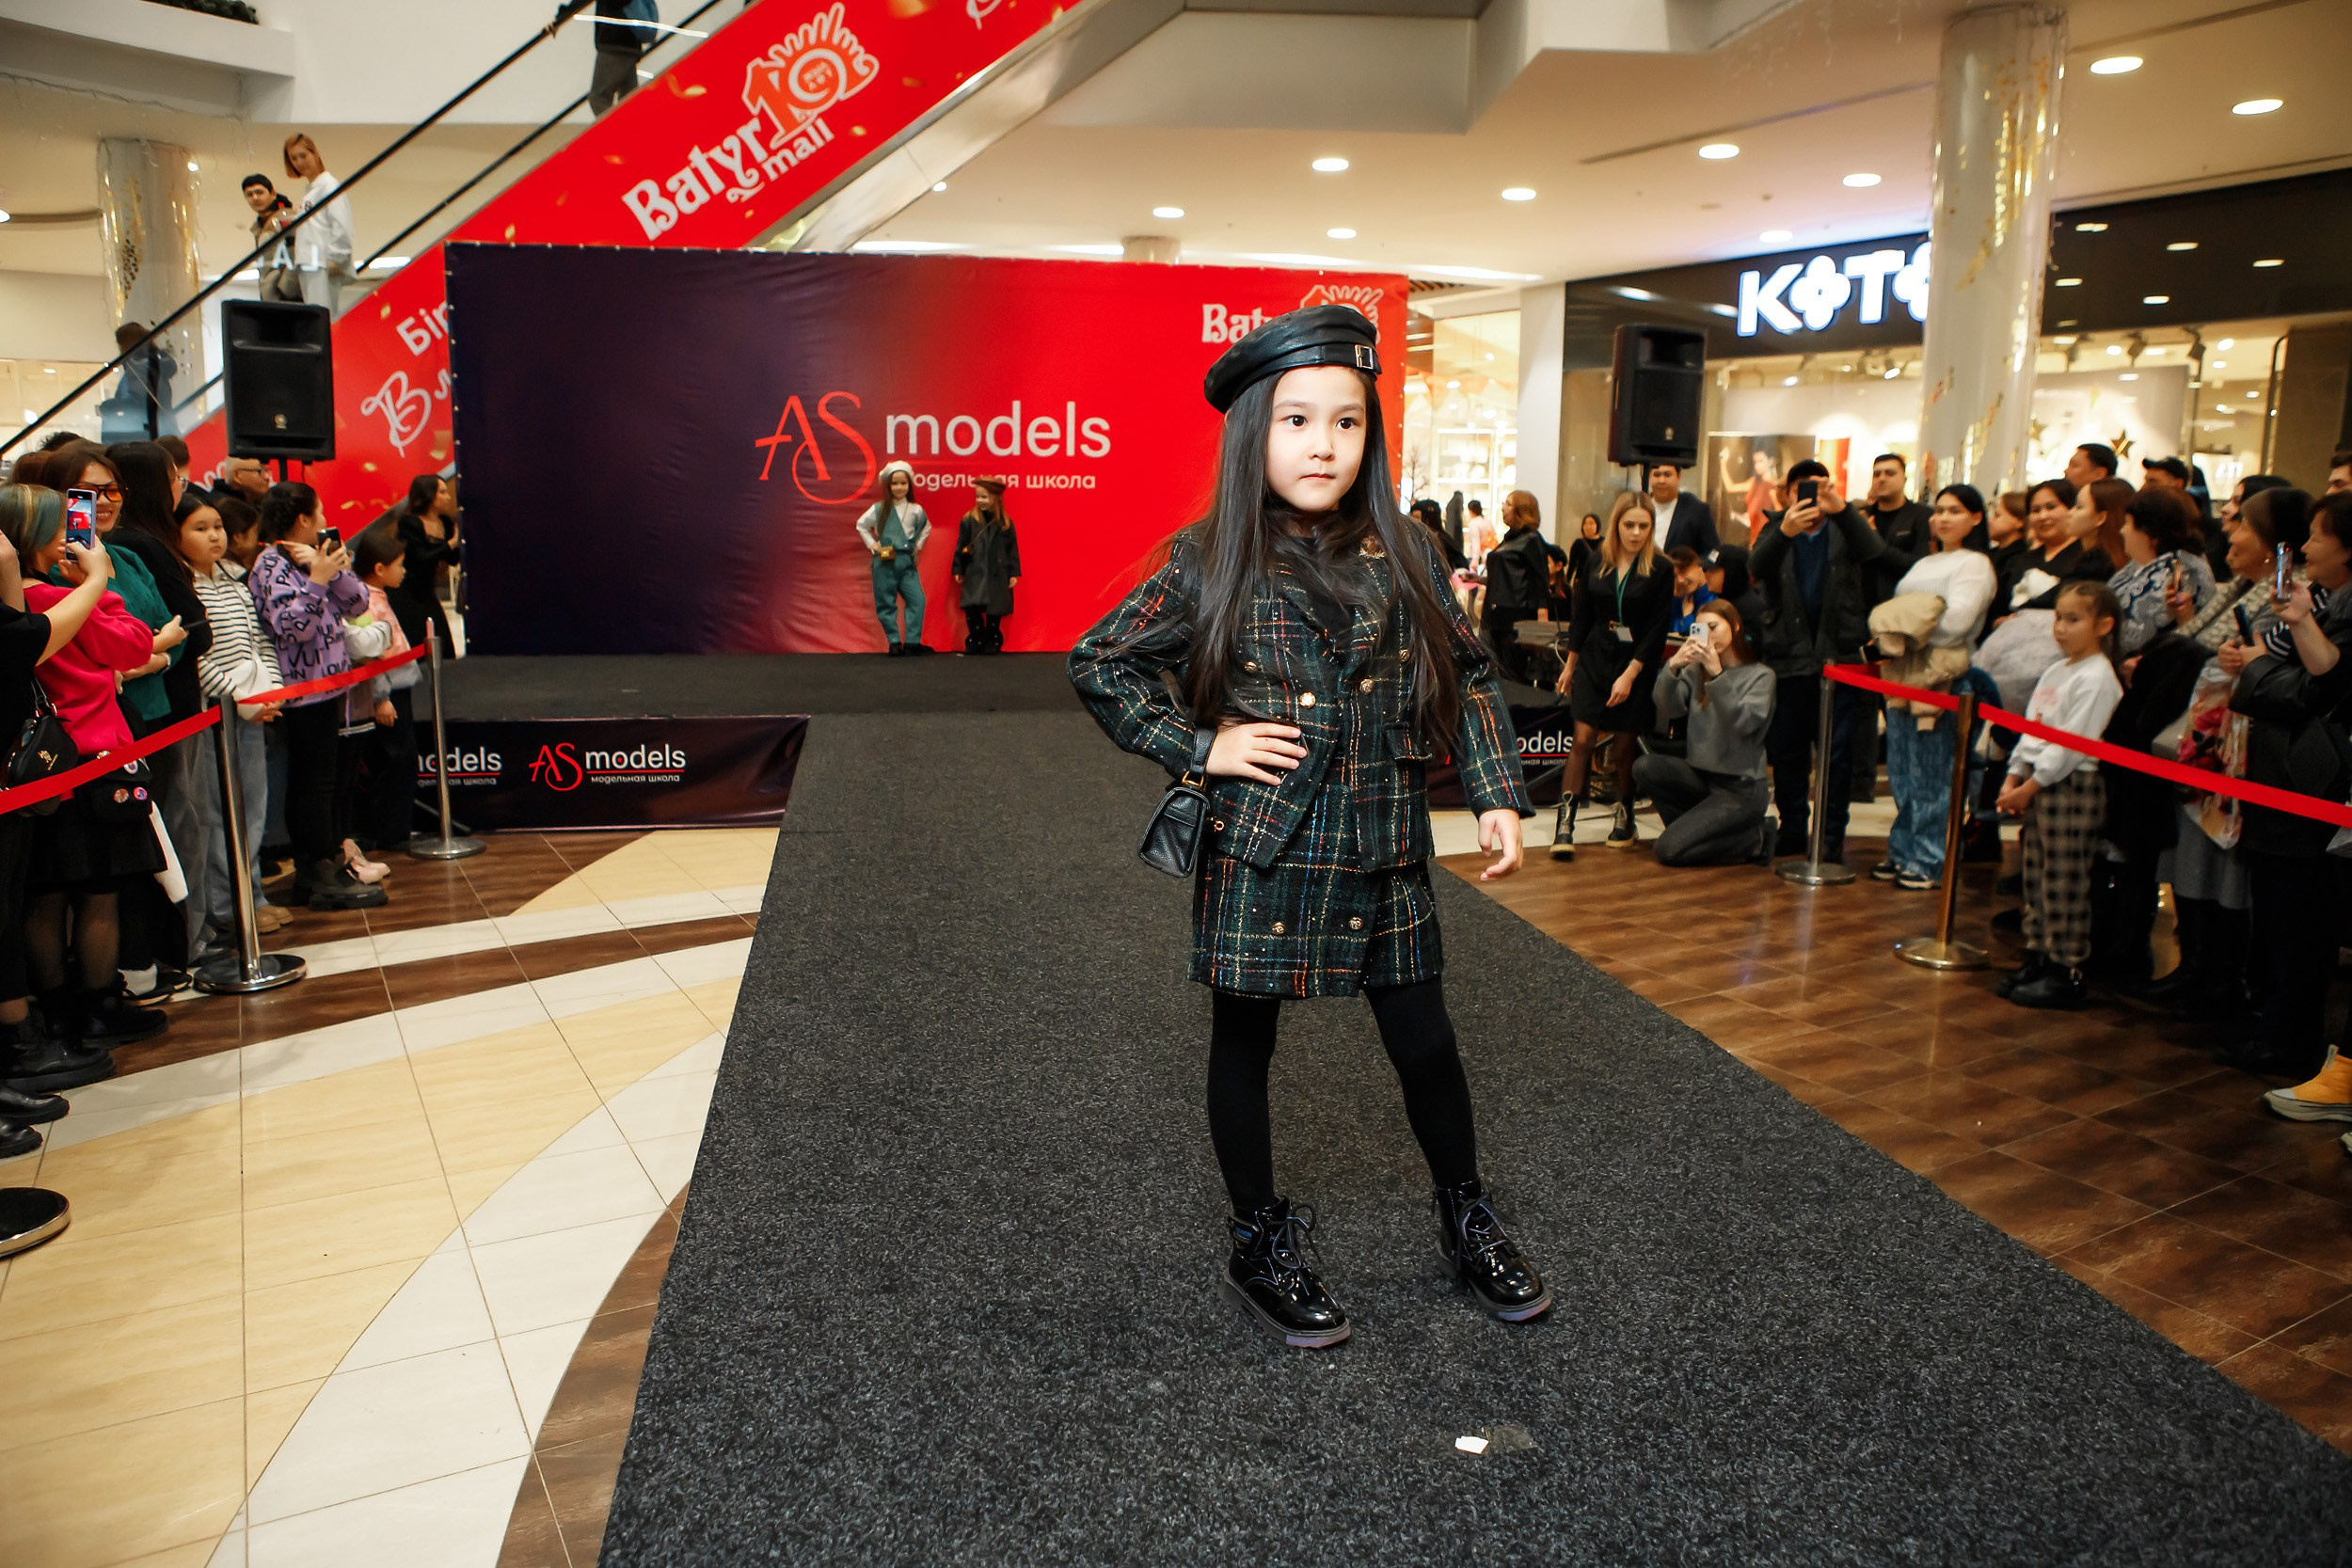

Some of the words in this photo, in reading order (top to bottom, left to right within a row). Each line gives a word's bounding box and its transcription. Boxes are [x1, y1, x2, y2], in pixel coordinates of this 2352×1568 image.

[761, 118, 835, 182] mall
[622, 117, 769, 242] Batyr
[1201, 303, 1274, 343] Bat
[755, 391, 877, 504] AS
[886, 400, 1111, 458] models
[913, 473, 1019, 492] одельая
[1025, 475, 1096, 489] школа
[418, 746, 502, 772] odels
[1517, 730, 1574, 752] odels
[529, 742, 583, 792] AS
[585, 743, 687, 769] models
[591, 775, 646, 784] модельная
[648, 774, 680, 783] школа
